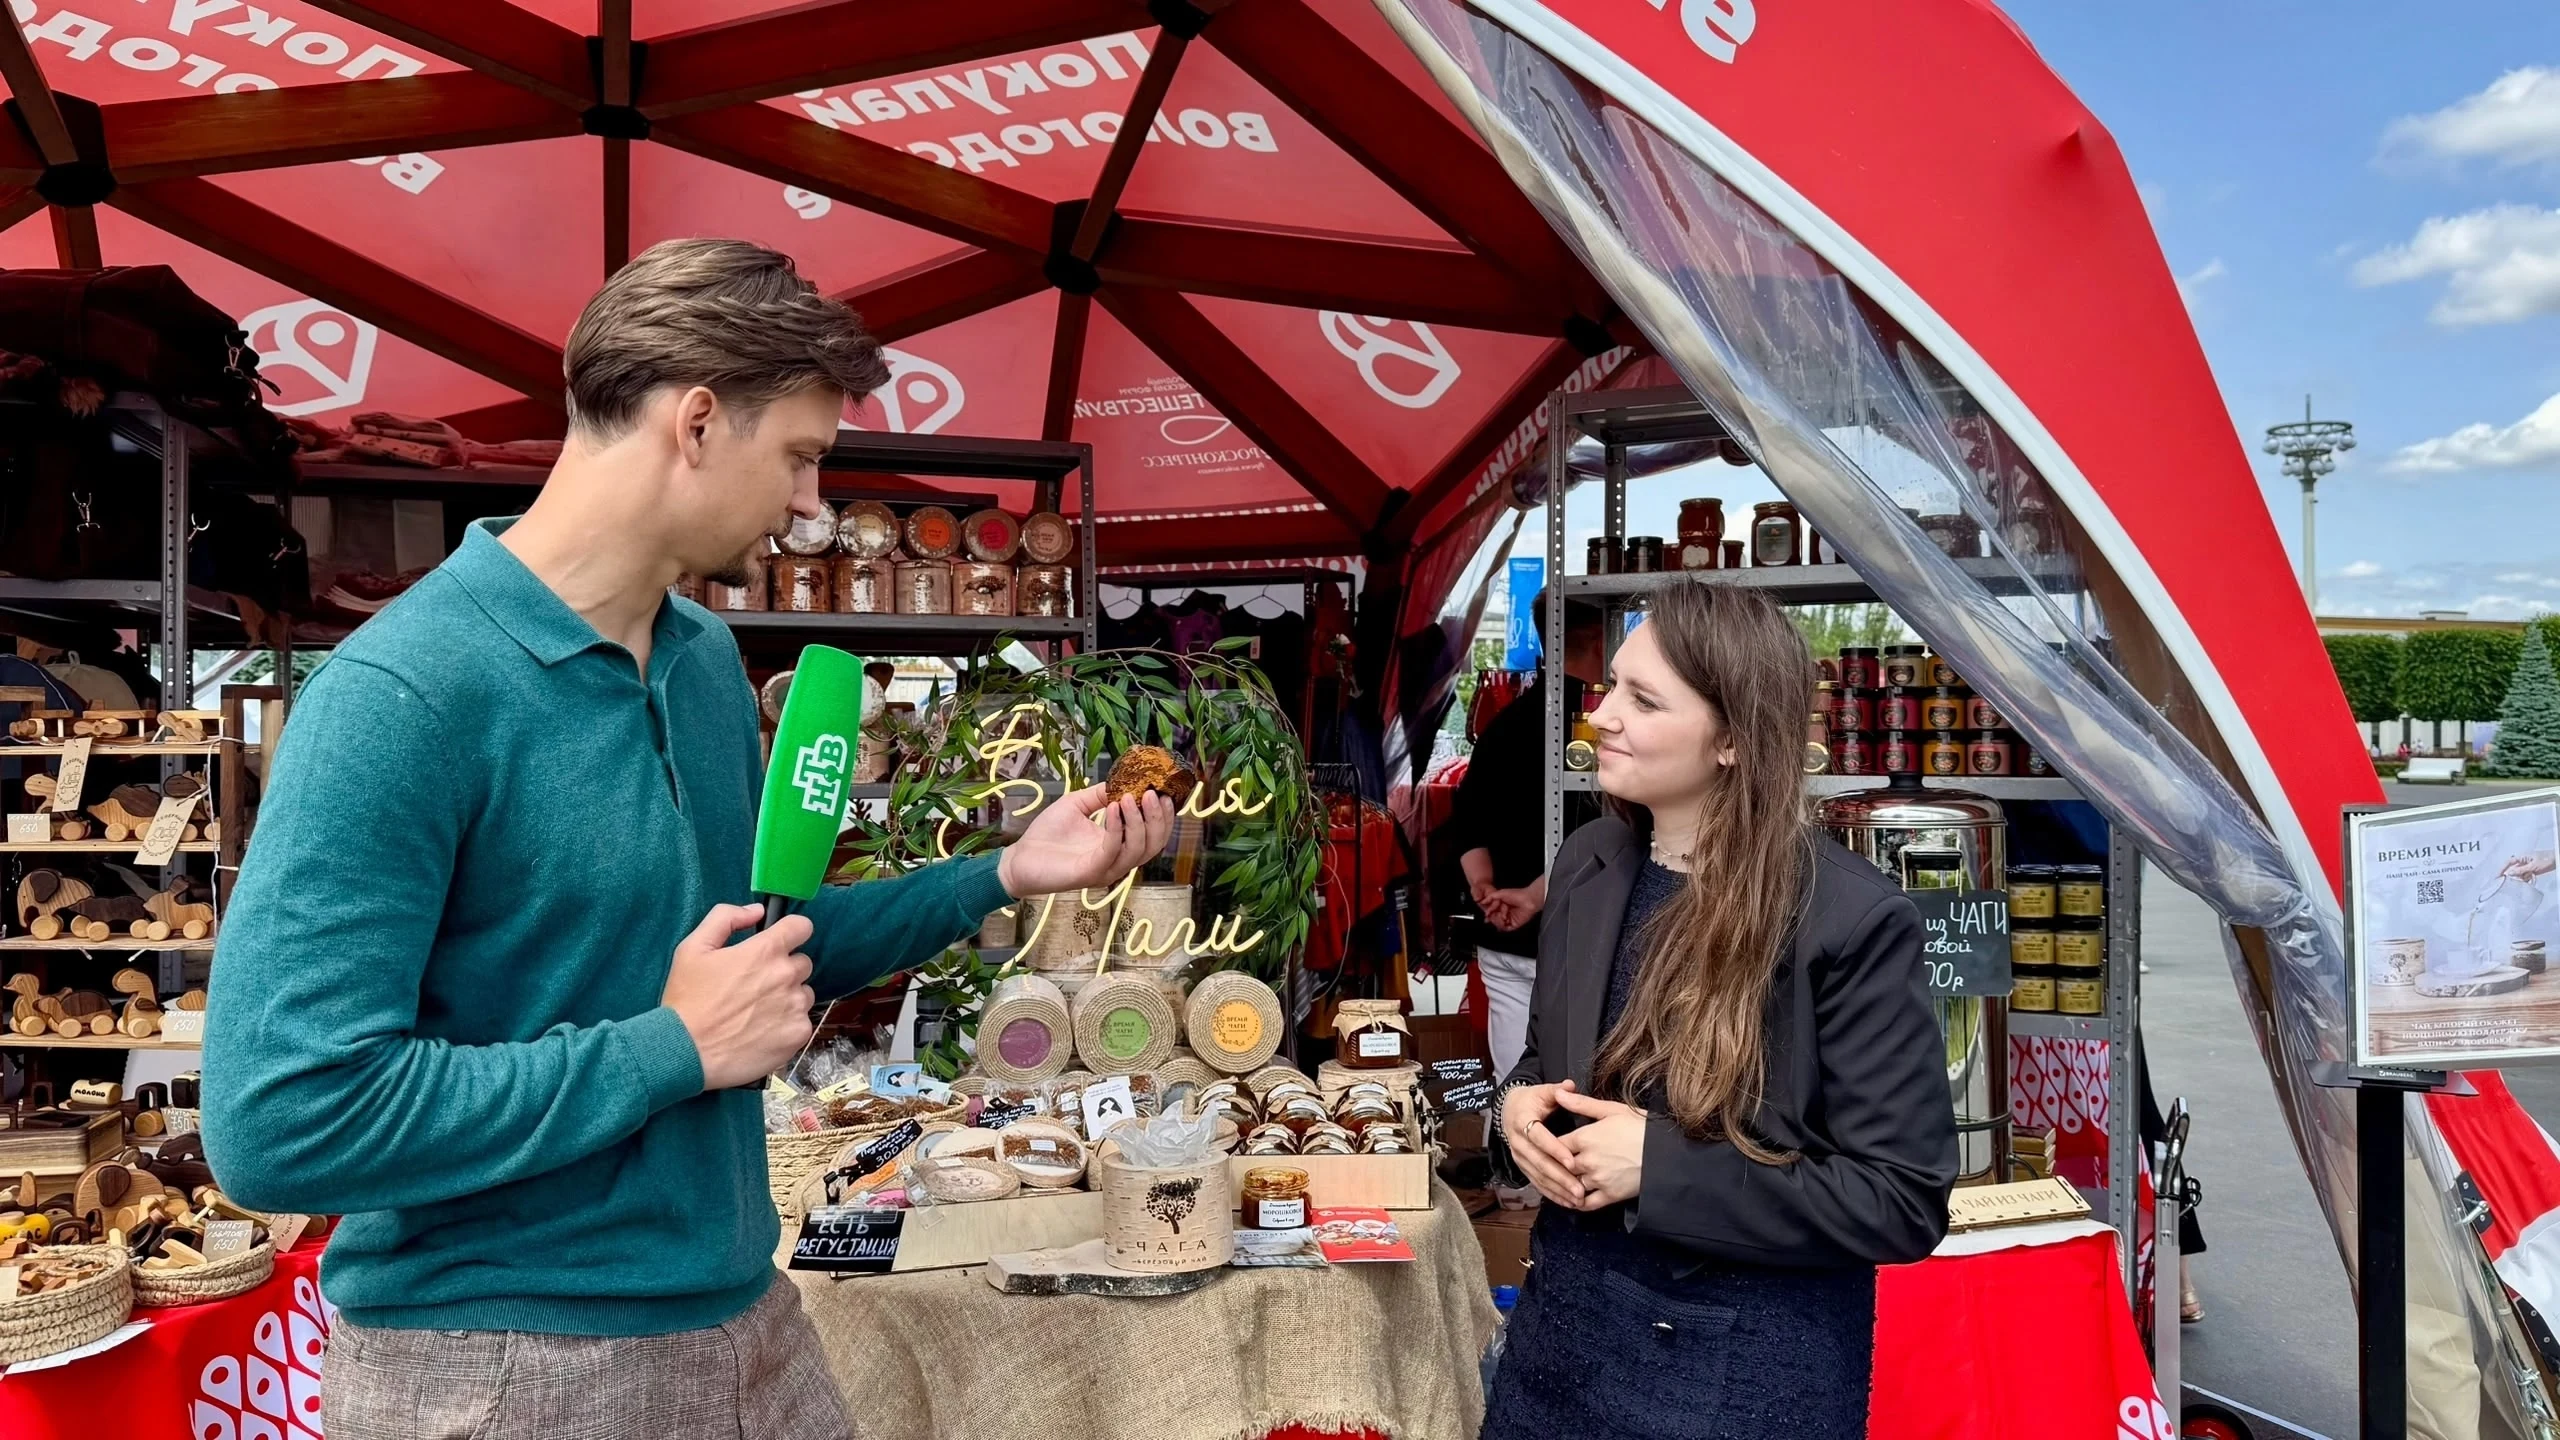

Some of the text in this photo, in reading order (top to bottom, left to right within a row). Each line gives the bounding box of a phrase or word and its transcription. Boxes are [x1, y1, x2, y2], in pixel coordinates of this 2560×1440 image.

[792, 733, 848, 816] НТВ
[2378, 840, 2481, 862] ВРЕМЯ ЧАГИ
[1949, 901, 2007, 935] ЧАГИ
[74, 1088, 106, 1098] МОЛОКО
[875, 1145, 899, 1168] 300
[1962, 1189, 2058, 1209] ЧАЙ ИЗ ЧАГИ
[818, 1214, 870, 1235] ЕСТЬ
[213, 1238, 239, 1251] 650
[794, 1237, 900, 1257] ДЕГУСТАЦИЯ
[1136, 1239, 1207, 1252] ЧАГА
